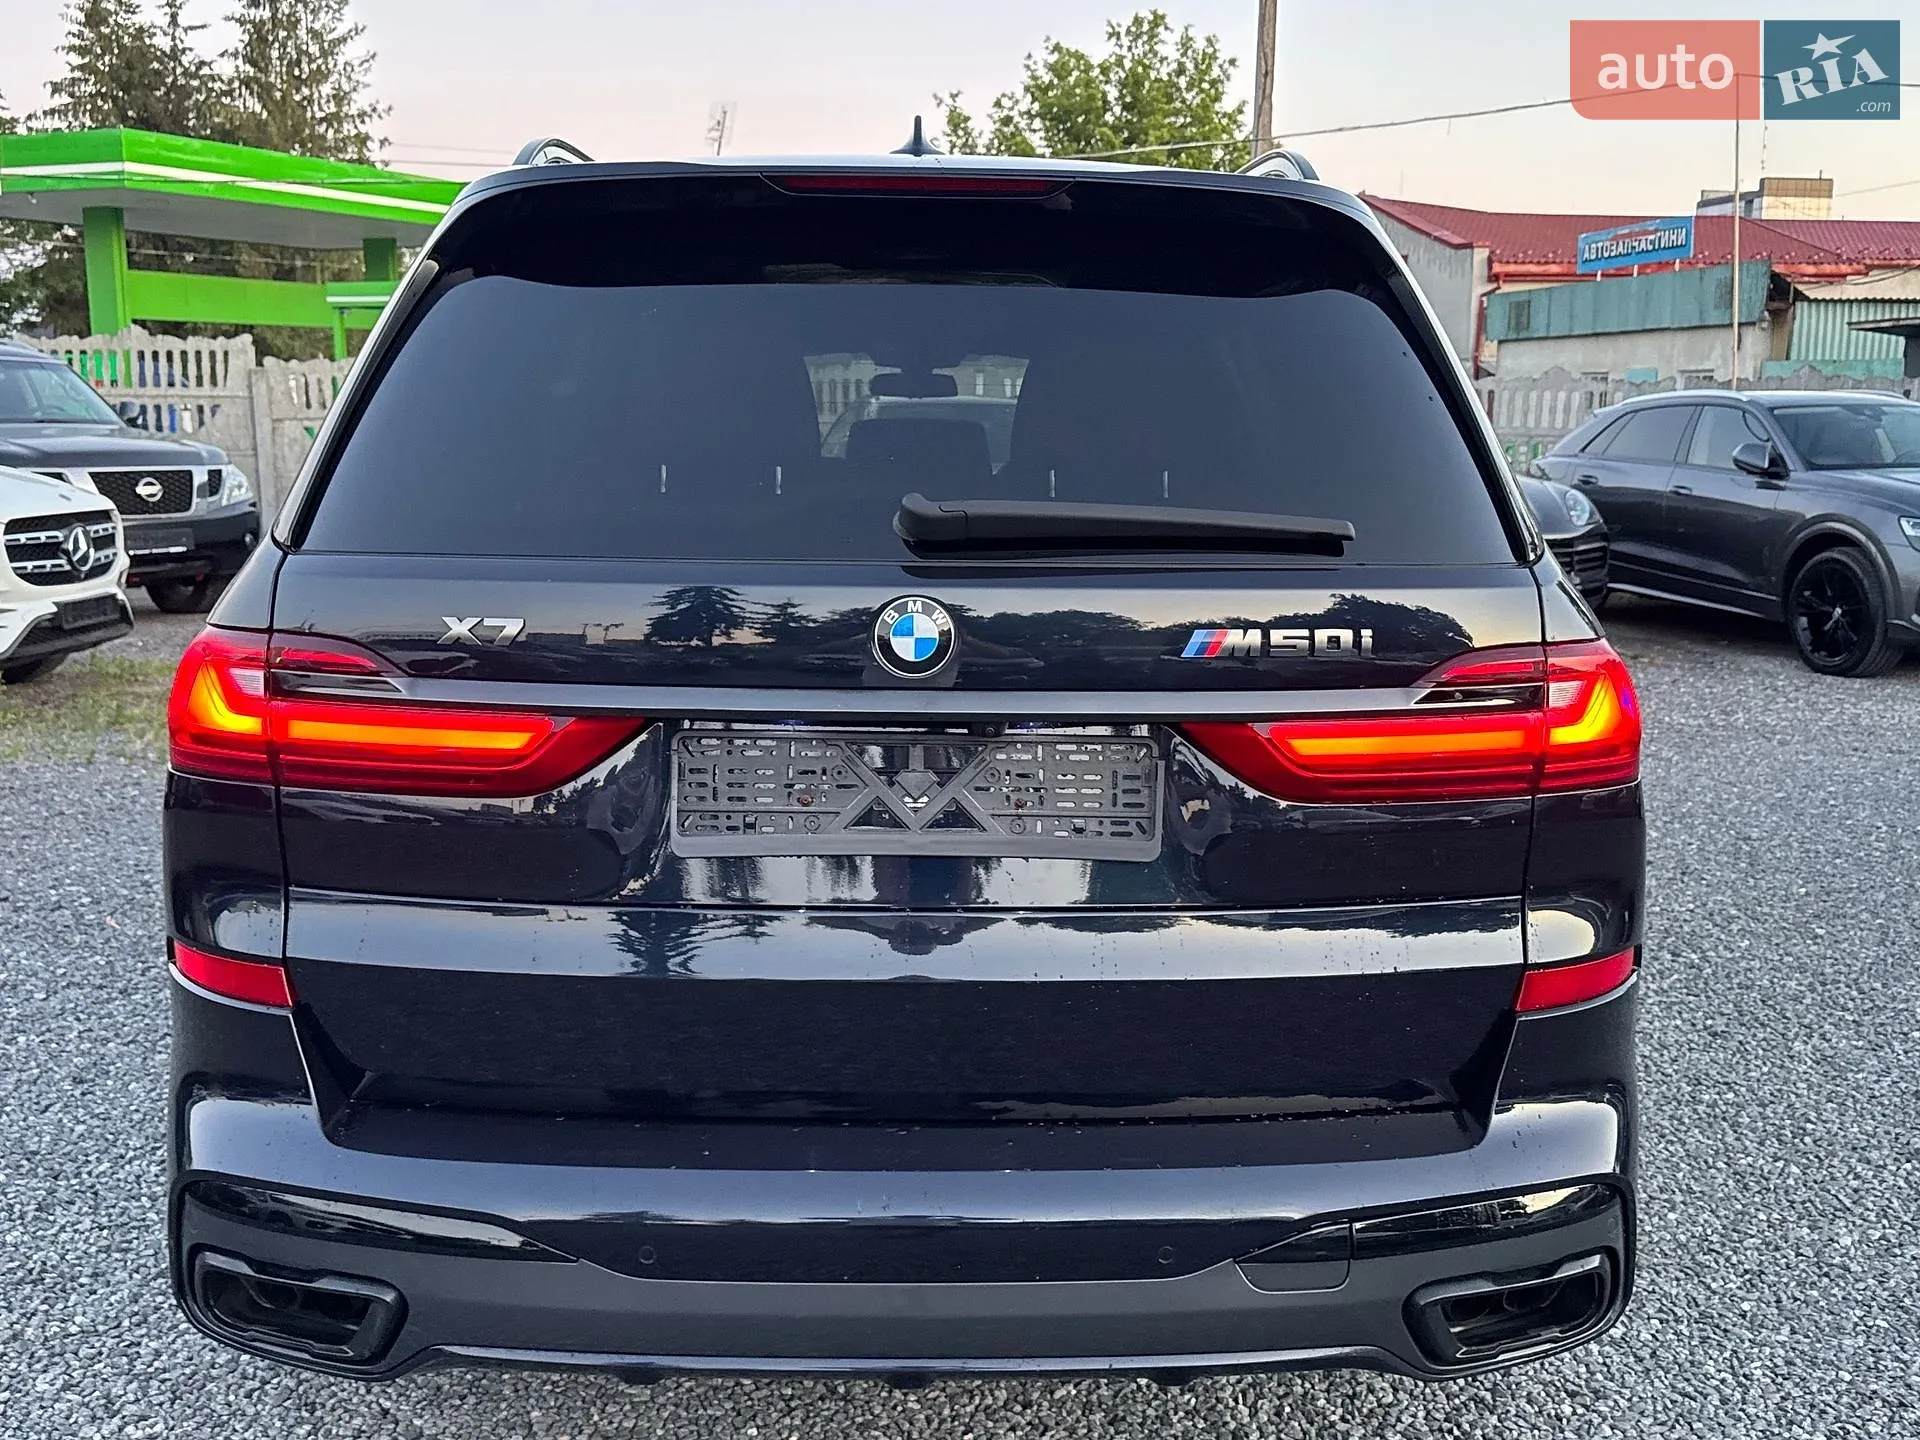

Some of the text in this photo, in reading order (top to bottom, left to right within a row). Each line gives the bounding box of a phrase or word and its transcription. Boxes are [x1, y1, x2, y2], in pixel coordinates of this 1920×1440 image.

[1583, 227, 1686, 261] АВТОЗАПЧАСТИНИ
[883, 600, 947, 625] BMW
[436, 616, 525, 646] X7
[1217, 629, 1373, 657] M50i
